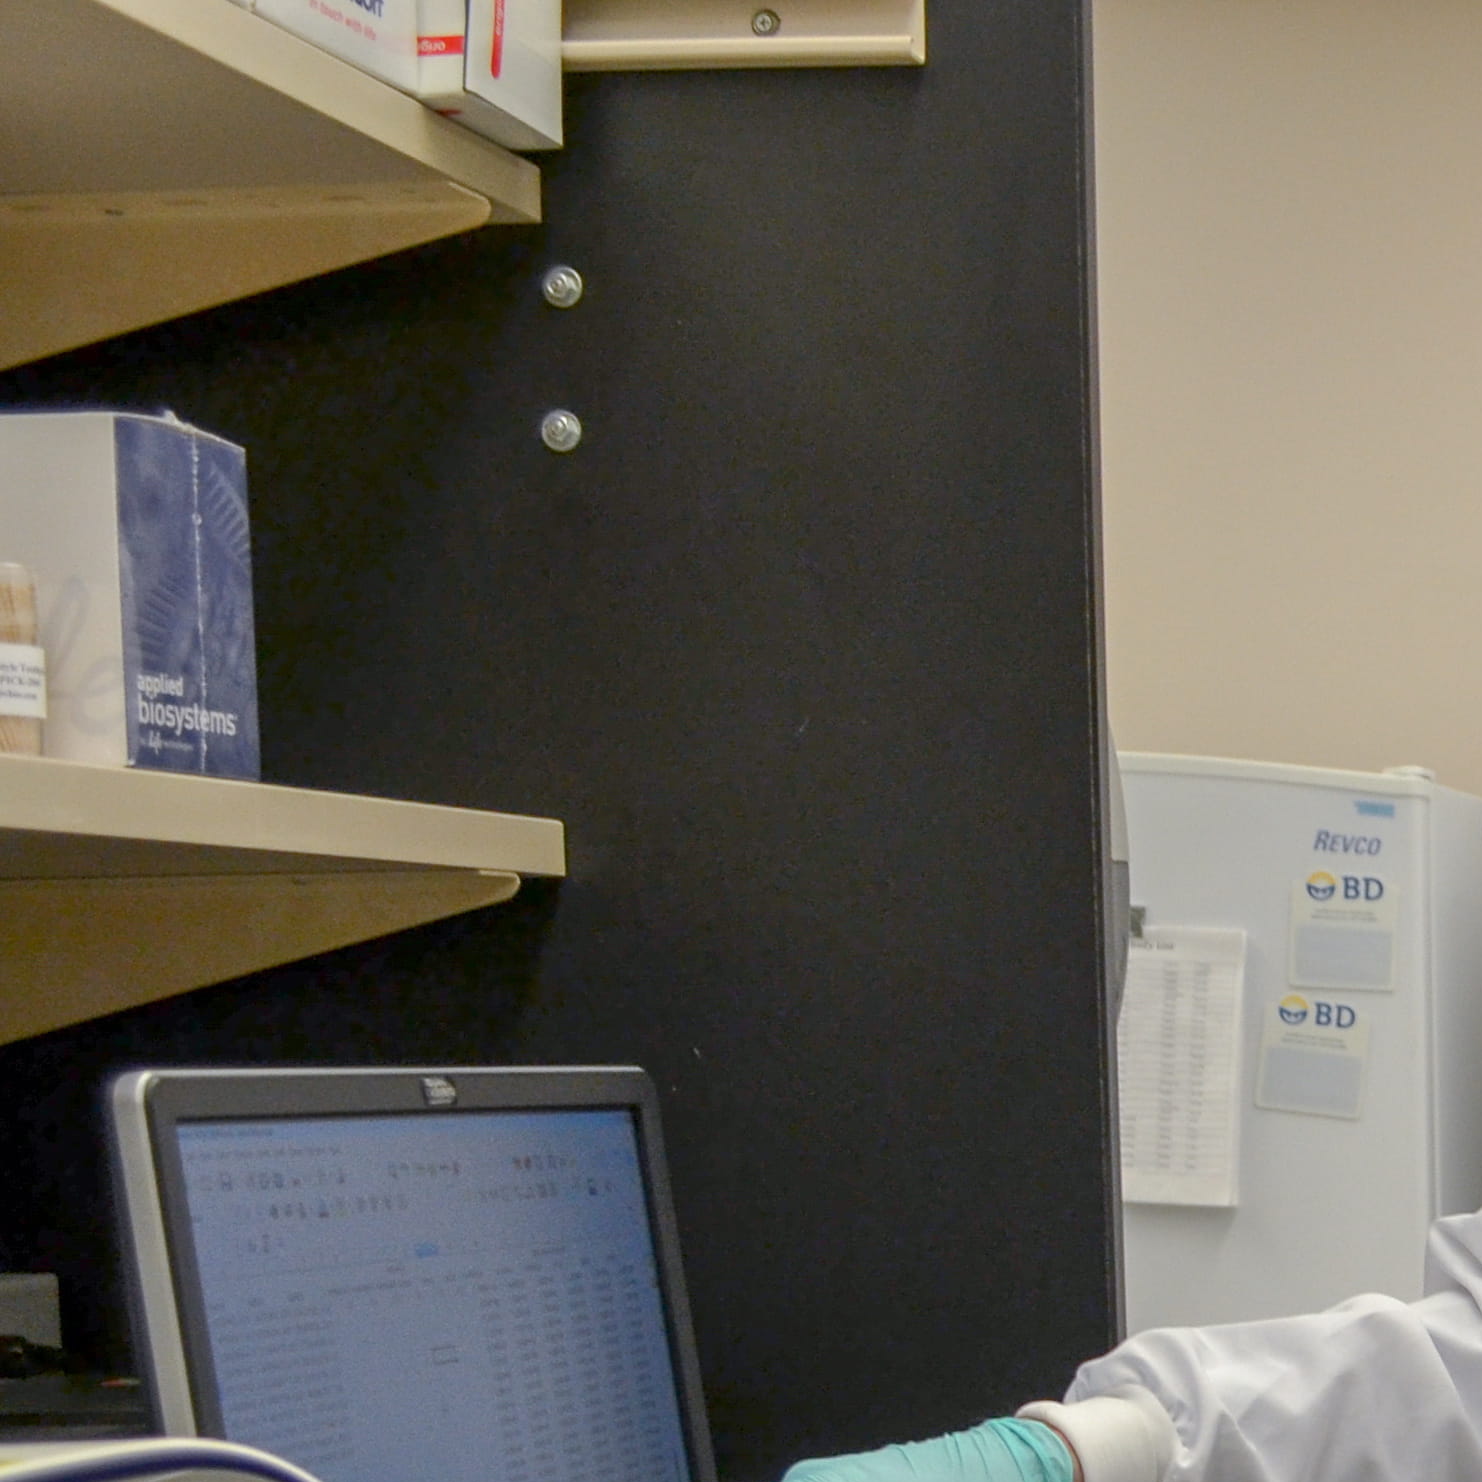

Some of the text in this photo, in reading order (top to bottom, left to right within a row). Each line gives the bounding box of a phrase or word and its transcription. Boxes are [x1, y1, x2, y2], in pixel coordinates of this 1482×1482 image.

[137, 673, 184, 699] applied
[138, 692, 237, 737] biosystems
[1313, 829, 1381, 857] REVCO
[1342, 876, 1385, 902] BD
[1314, 1002, 1356, 1029] BD
